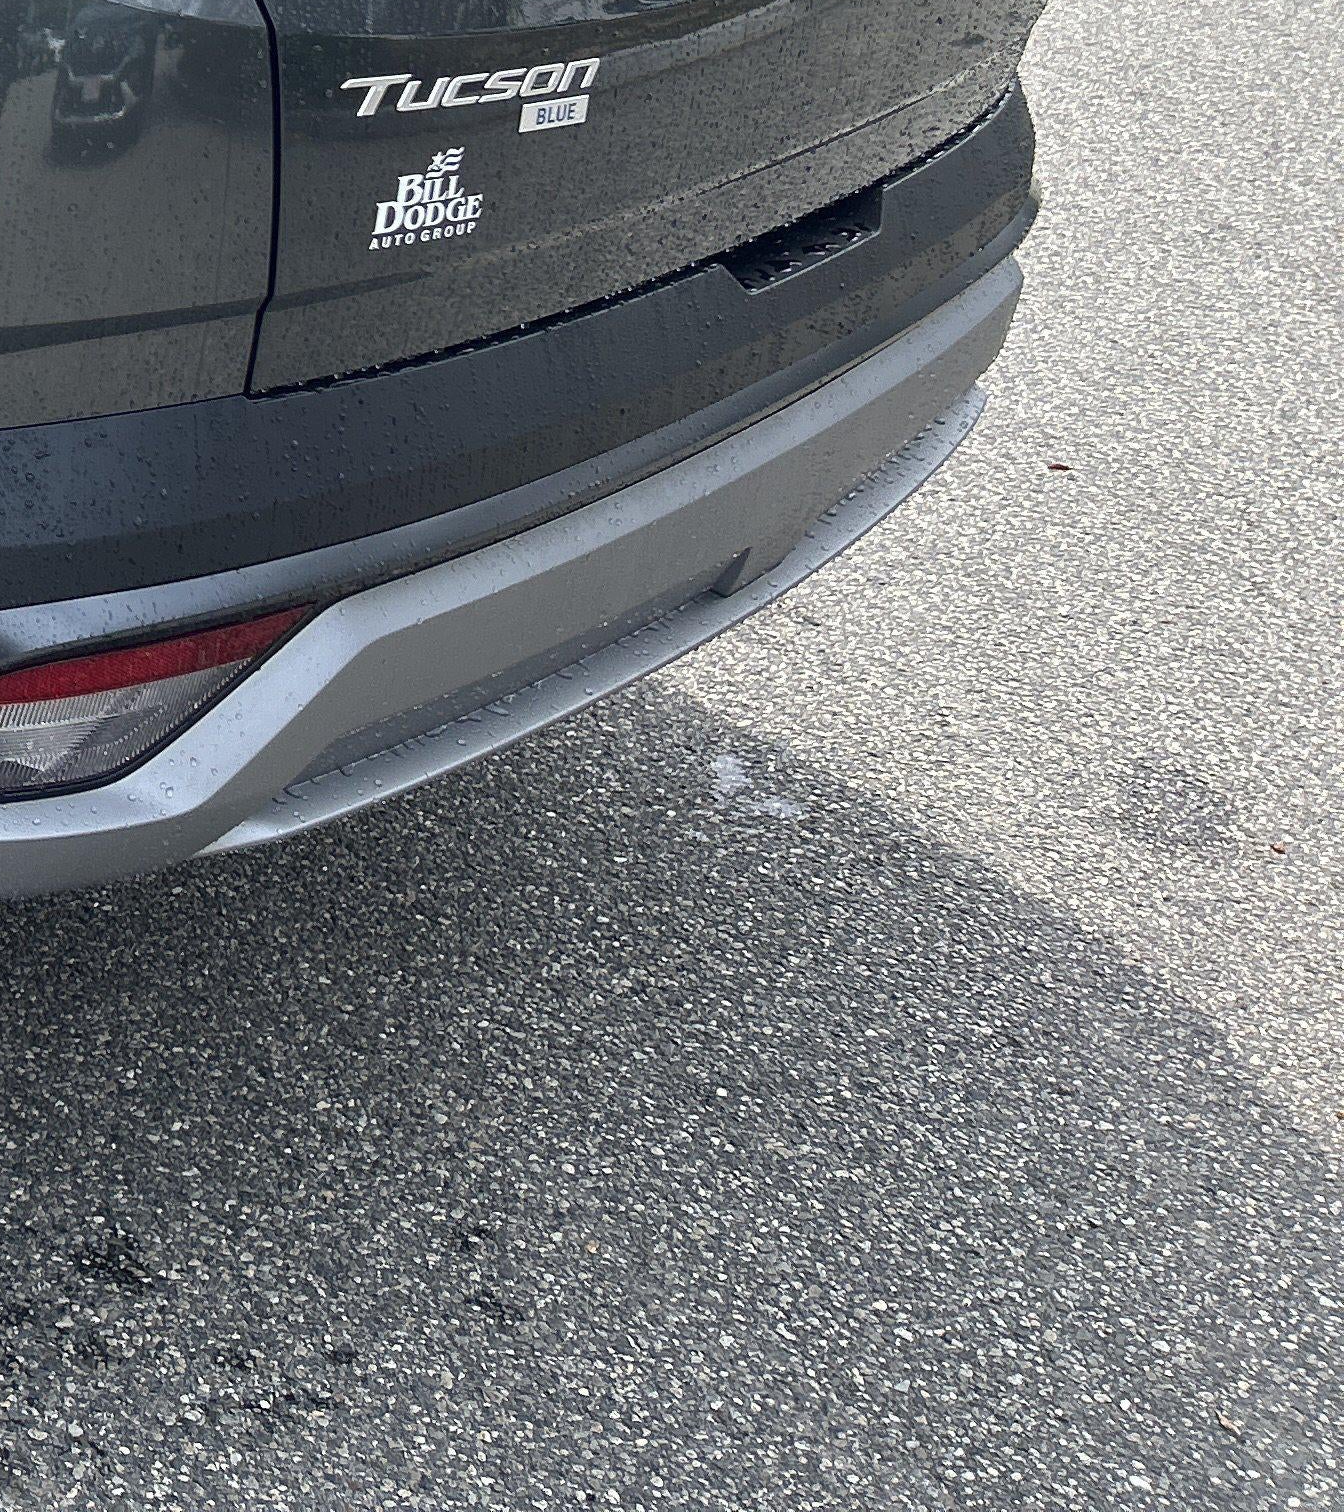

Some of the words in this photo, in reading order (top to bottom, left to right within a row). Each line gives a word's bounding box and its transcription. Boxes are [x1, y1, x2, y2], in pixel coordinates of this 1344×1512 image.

[535, 102, 578, 126] BLUE
[396, 173, 466, 208] BILL
[371, 193, 484, 236] DODGE
[368, 234, 415, 251] AUTO
[419, 220, 477, 243] GROUP
